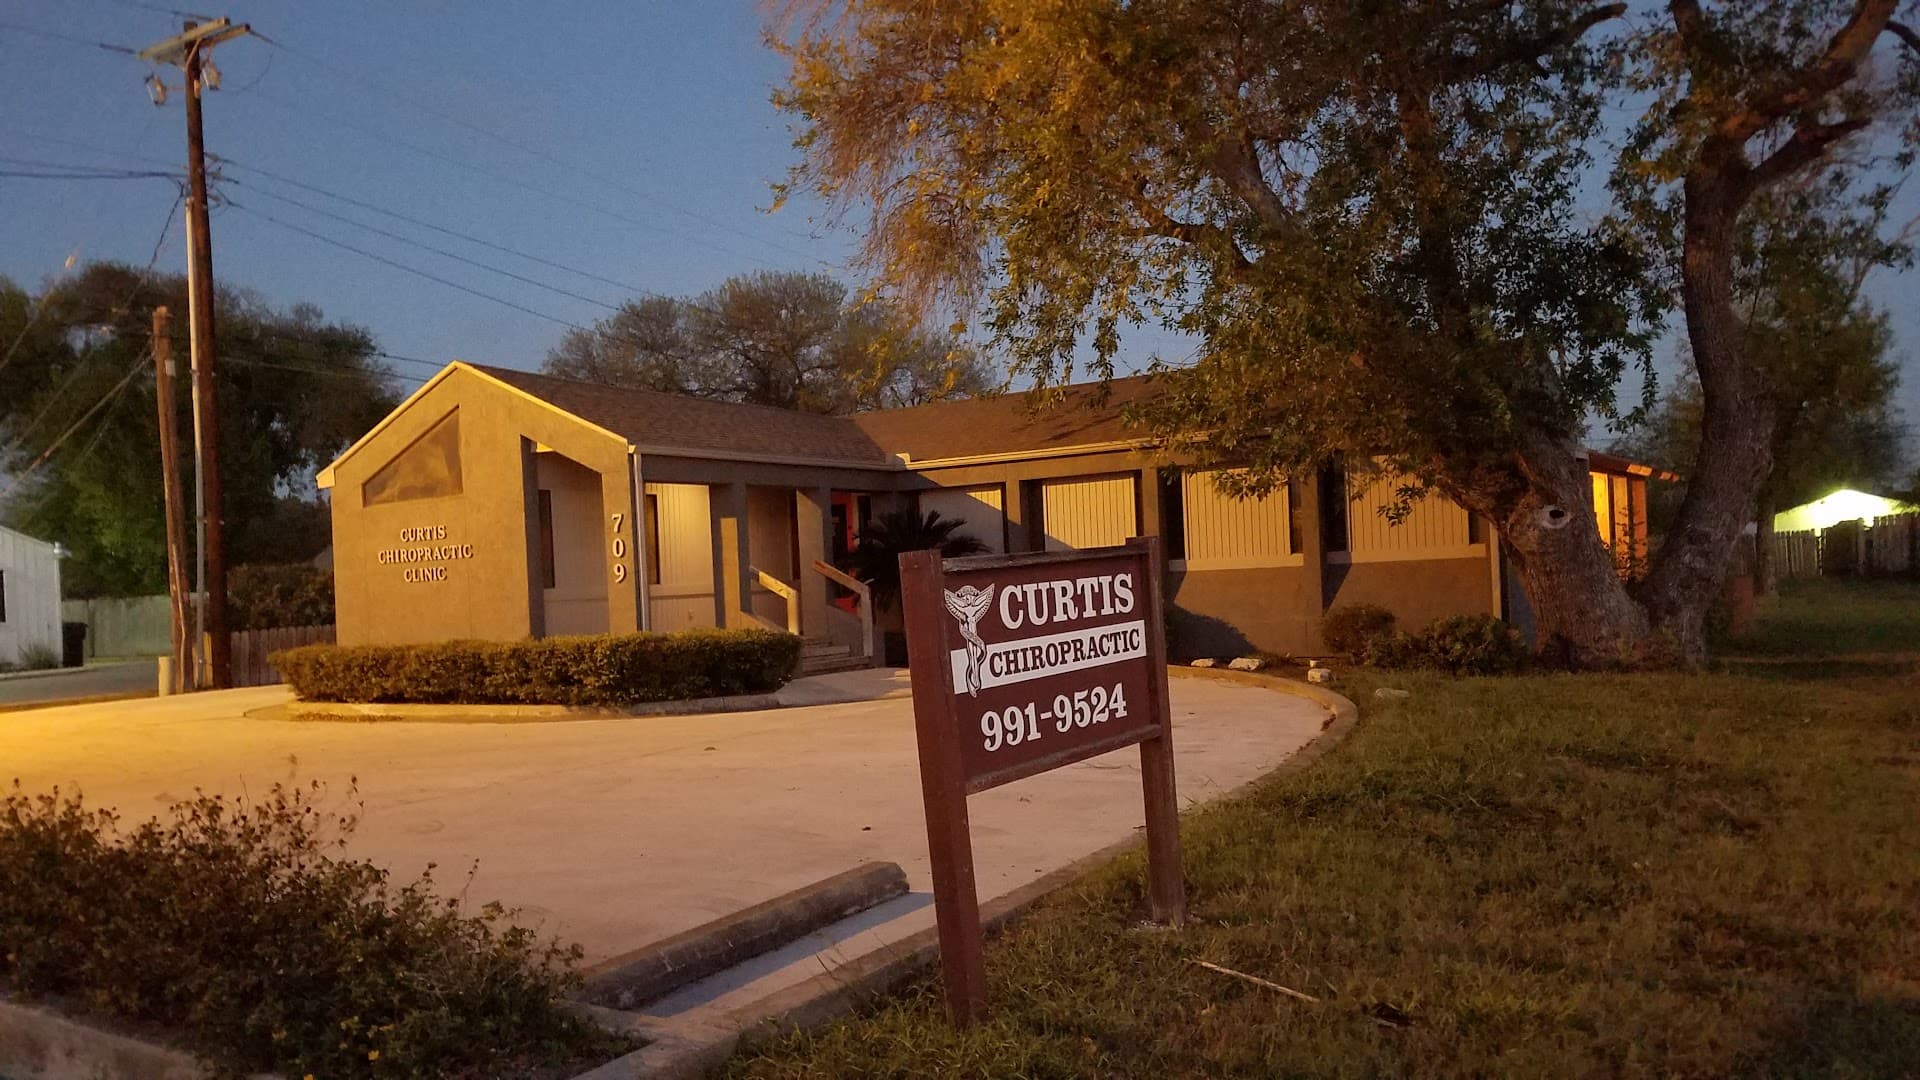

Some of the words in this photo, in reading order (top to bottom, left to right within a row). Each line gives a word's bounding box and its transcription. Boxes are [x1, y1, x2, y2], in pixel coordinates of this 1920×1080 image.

[378, 544, 473, 564] CHIROPRACTIC
[400, 525, 447, 542] CURTIS
[612, 513, 626, 583] 709
[404, 567, 447, 582] CLINIC
[999, 573, 1135, 630] CURTIS
[989, 628, 1140, 677] CHIROPRACTIC
[981, 682, 1128, 752] 991-9524
